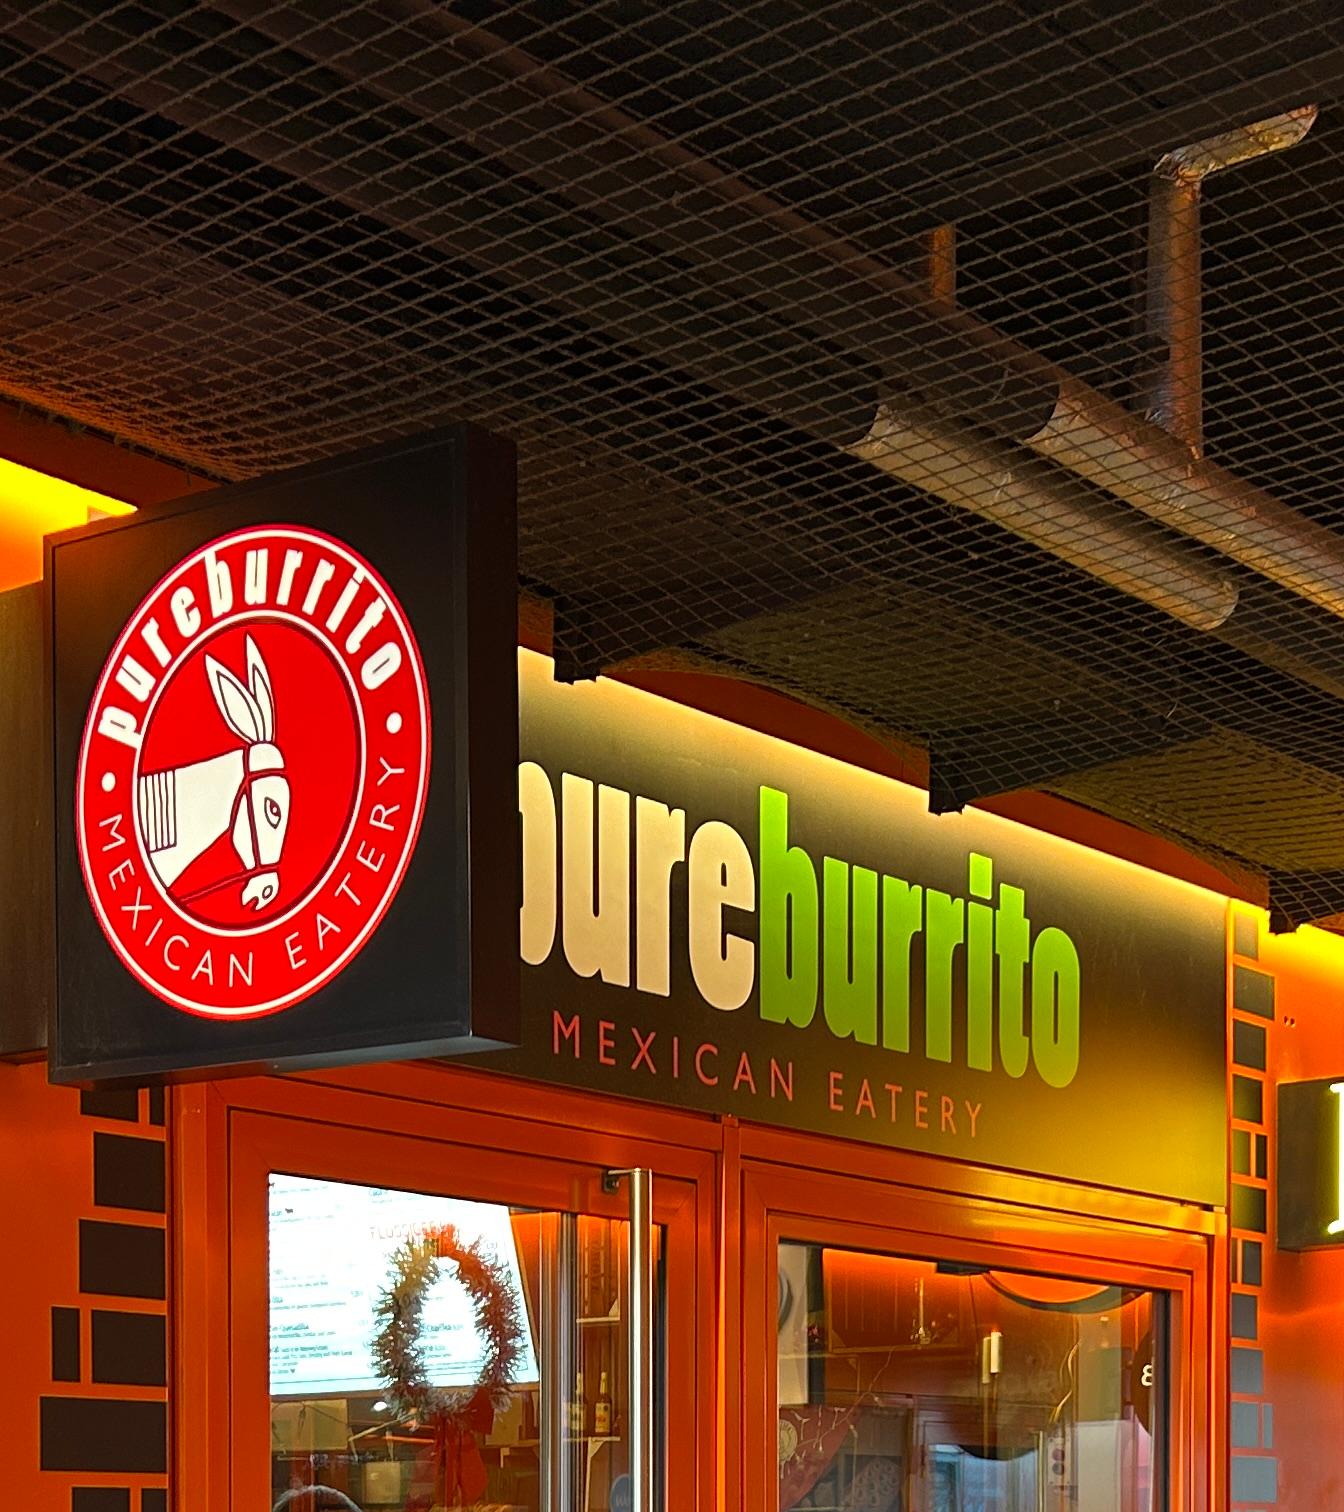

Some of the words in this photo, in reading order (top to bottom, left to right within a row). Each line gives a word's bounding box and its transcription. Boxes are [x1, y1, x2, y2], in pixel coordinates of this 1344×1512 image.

[96, 540, 404, 750] pureburrito
[96, 812, 256, 990] MEXICAN
[284, 752, 410, 970] EATERY
[551, 1009, 796, 1102] MEXICAN
[828, 1074, 986, 1140] EATERY
